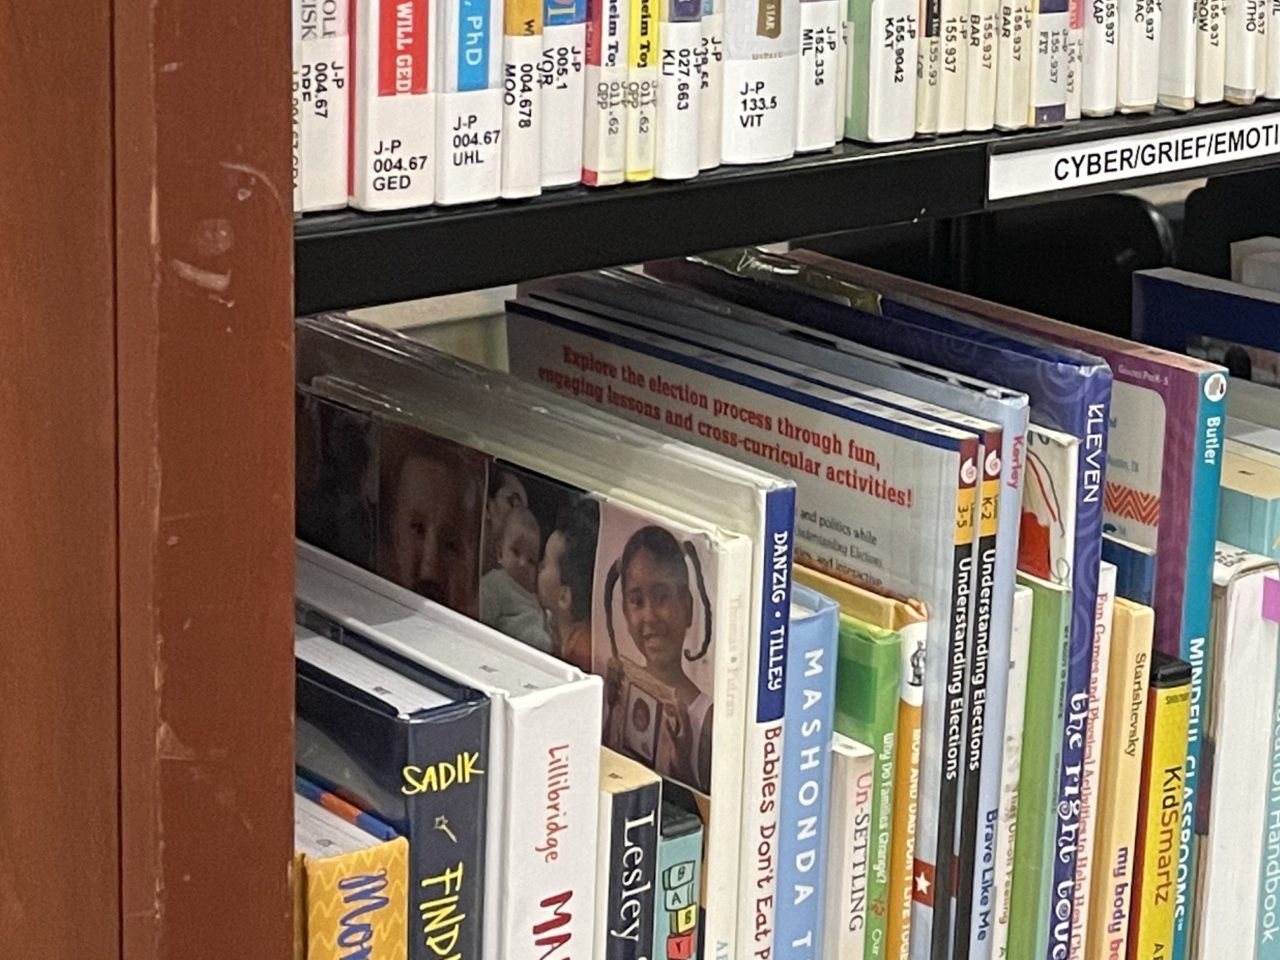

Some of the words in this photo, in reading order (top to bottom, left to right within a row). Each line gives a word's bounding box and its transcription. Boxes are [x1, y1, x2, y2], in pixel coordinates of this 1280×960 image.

[373, 175, 411, 191] GED
[374, 140, 402, 155] J-P
[374, 156, 427, 172] 004.67
[537, 367, 604, 401] engaging
[607, 386, 662, 420] lessons
[664, 406, 694, 431] and
[697, 421, 822, 478] cross-curricular
[825, 465, 914, 508] activities!
[562, 344, 618, 380] Explore
[620, 362, 646, 385] the
[648, 374, 709, 409] election
[712, 397, 772, 431] process
[777, 418, 843, 455] through
[847, 439, 881, 472] fun,
[1204, 416, 1222, 466] Butler
[1082, 403, 1106, 504] KLEVEN
[770, 531, 788, 604] DANZIG
[767, 624, 785, 691] TILLEY
[947, 556, 973, 694] Understanding
[400, 751, 485, 796] SADIK
[760, 725, 784, 814] Babies
[793, 648, 825, 906] MASHONDA
[945, 697, 964, 781] Elections
[537, 743, 570, 864] Lillibridge
[1154, 766, 1183, 907] KidSmartz
[609, 810, 655, 942] Lesley
[757, 822, 777, 889] Don't
[754, 895, 774, 942] Eat
